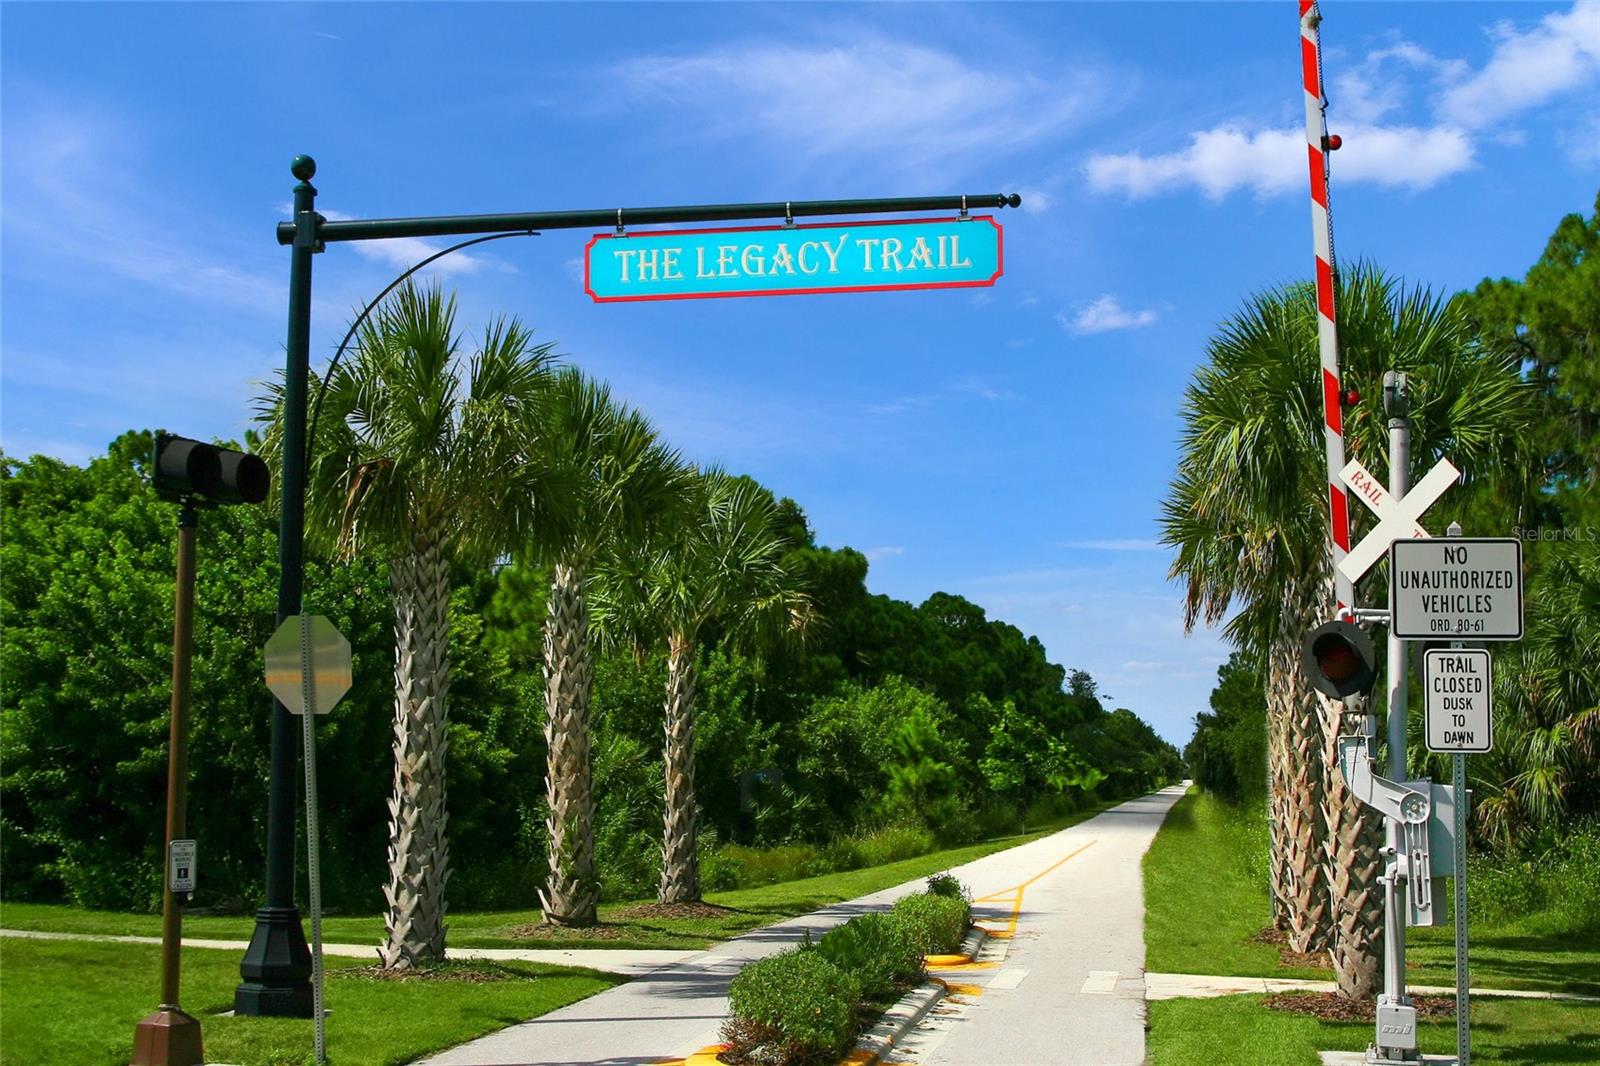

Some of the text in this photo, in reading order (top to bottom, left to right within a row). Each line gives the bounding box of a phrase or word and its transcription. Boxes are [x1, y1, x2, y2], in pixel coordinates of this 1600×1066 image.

[614, 233, 973, 282] THE LEGACY TRAIL
[1351, 471, 1382, 506] RAIL
[1444, 546, 1468, 564] NO
[1400, 571, 1513, 589] UNAUTHORIZED
[1422, 595, 1492, 613] VEHICLES
[1430, 619, 1484, 632] ORD. 80-61
[1438, 657, 1477, 673] TRAIL
[1434, 677, 1482, 693] CLOSED
[1443, 697, 1473, 710] DUSK
[1452, 714, 1465, 727] TO
[1444, 731, 1474, 744] DAWN
